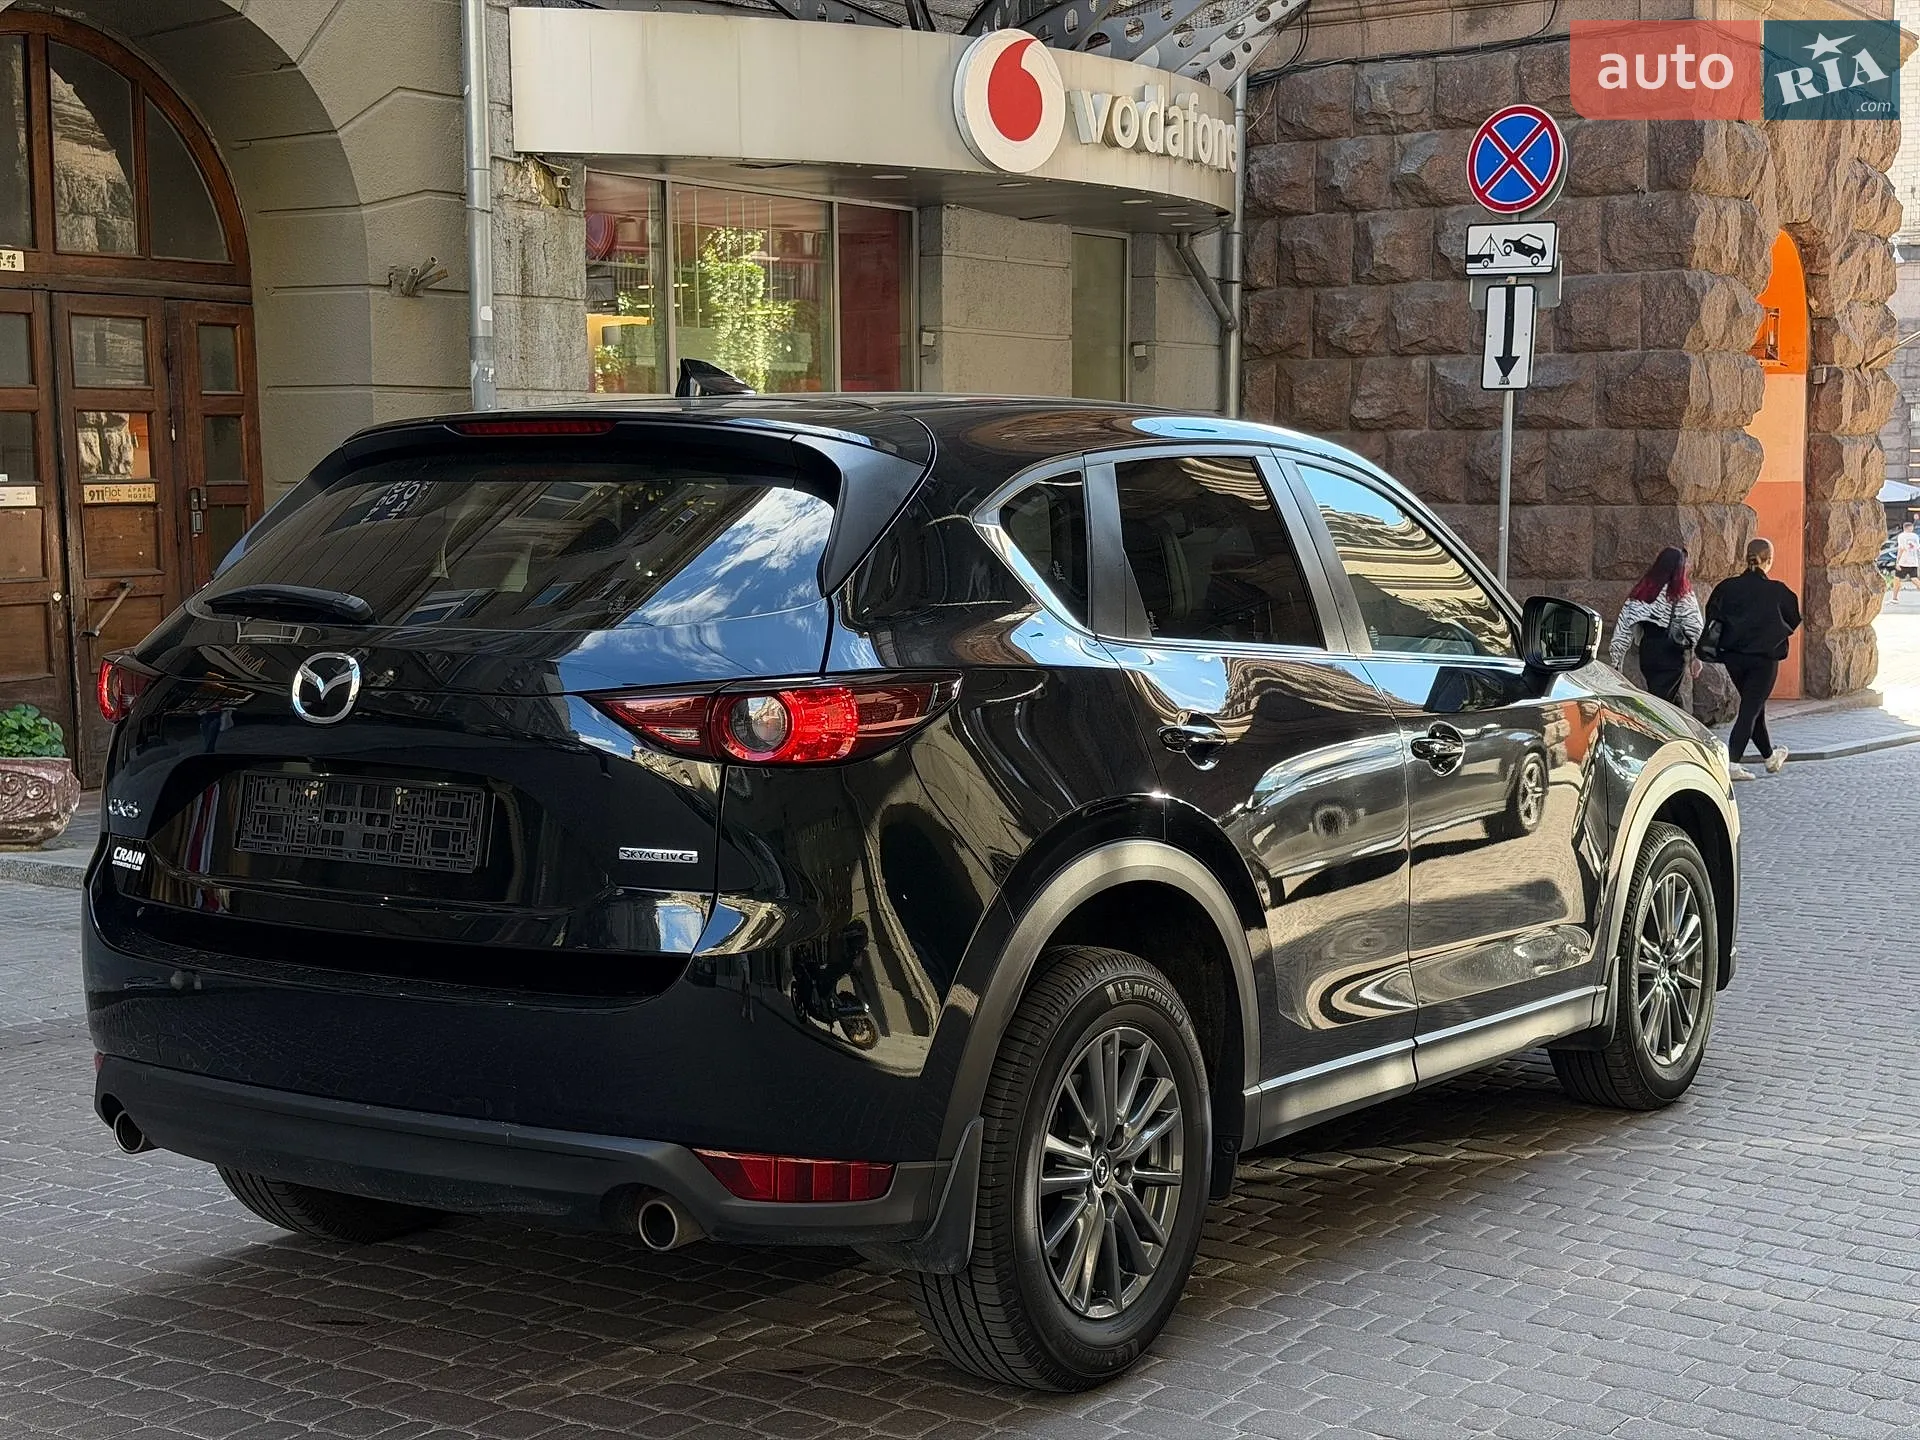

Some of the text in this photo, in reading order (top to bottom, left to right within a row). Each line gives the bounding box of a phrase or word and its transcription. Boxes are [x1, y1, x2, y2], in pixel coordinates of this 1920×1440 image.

[1069, 84, 1237, 173] vodafone
[113, 846, 146, 866] CRAIN
[1133, 983, 1183, 1022] MICHELIN
